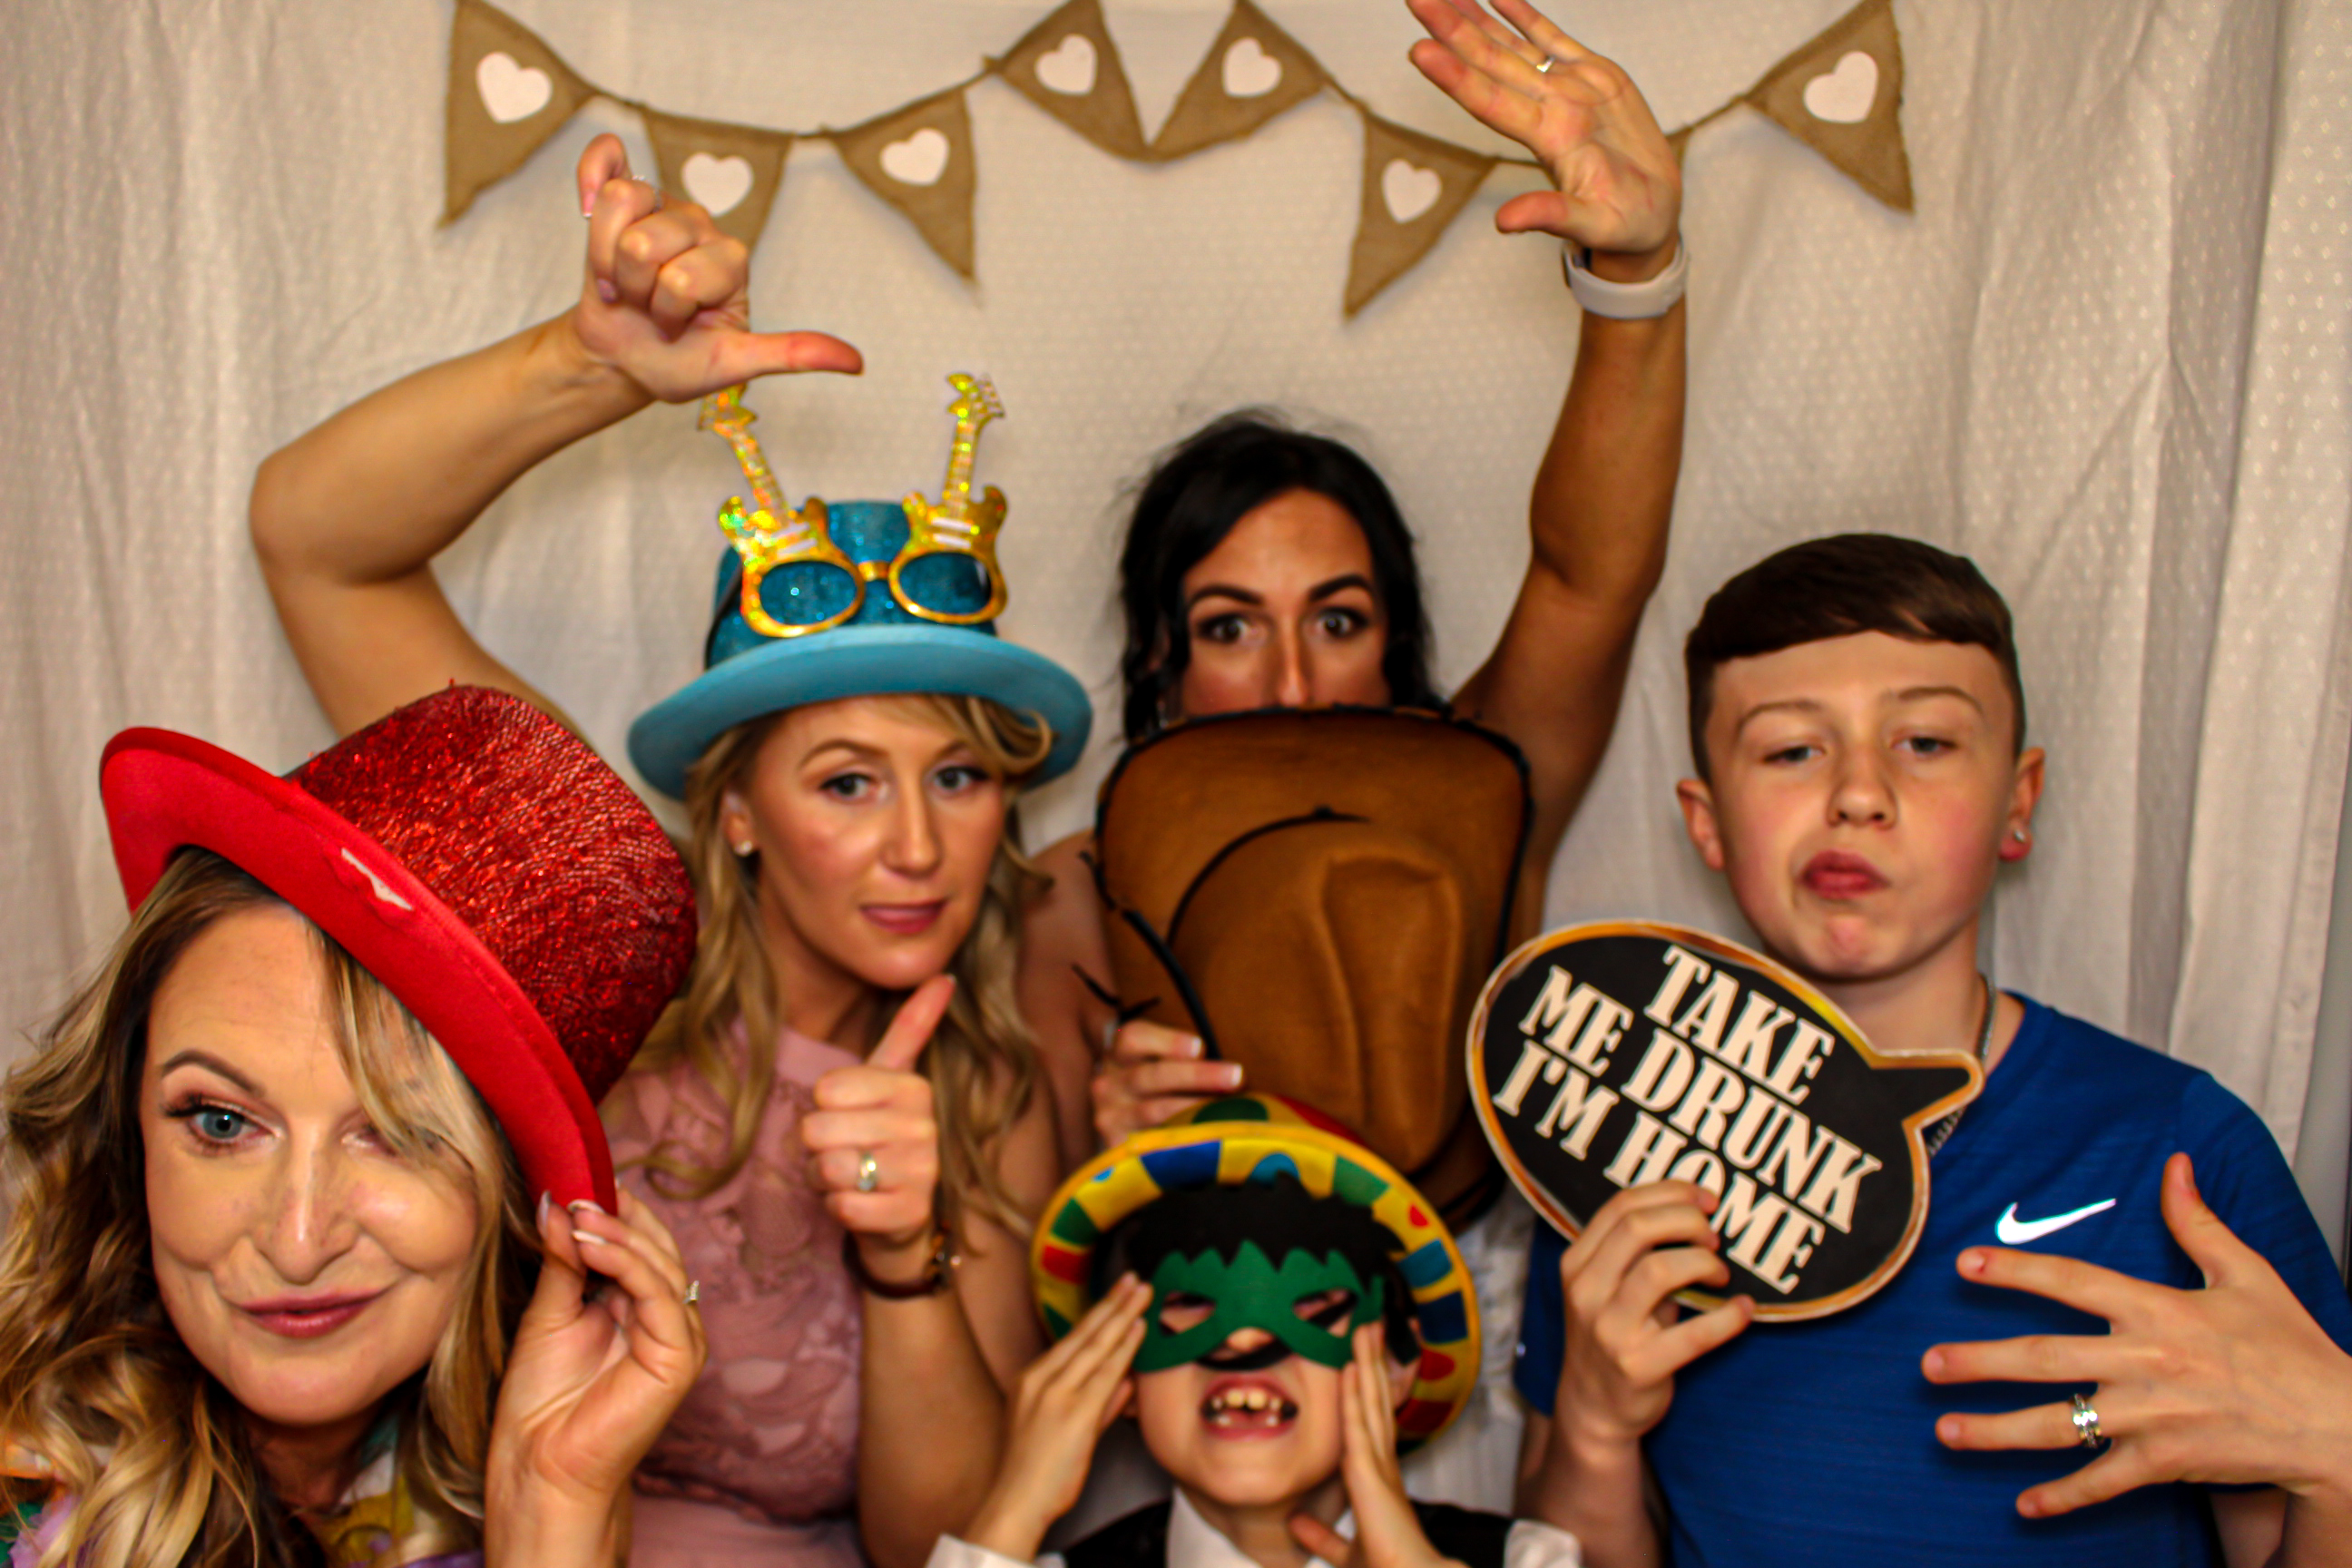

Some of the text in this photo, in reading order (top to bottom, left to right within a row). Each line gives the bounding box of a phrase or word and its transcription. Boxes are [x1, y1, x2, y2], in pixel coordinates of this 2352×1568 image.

[1492, 1040, 1620, 1161] I'M
[1518, 965, 1882, 1233] ME DRUNK
[1643, 945, 1835, 1104] TAKE
